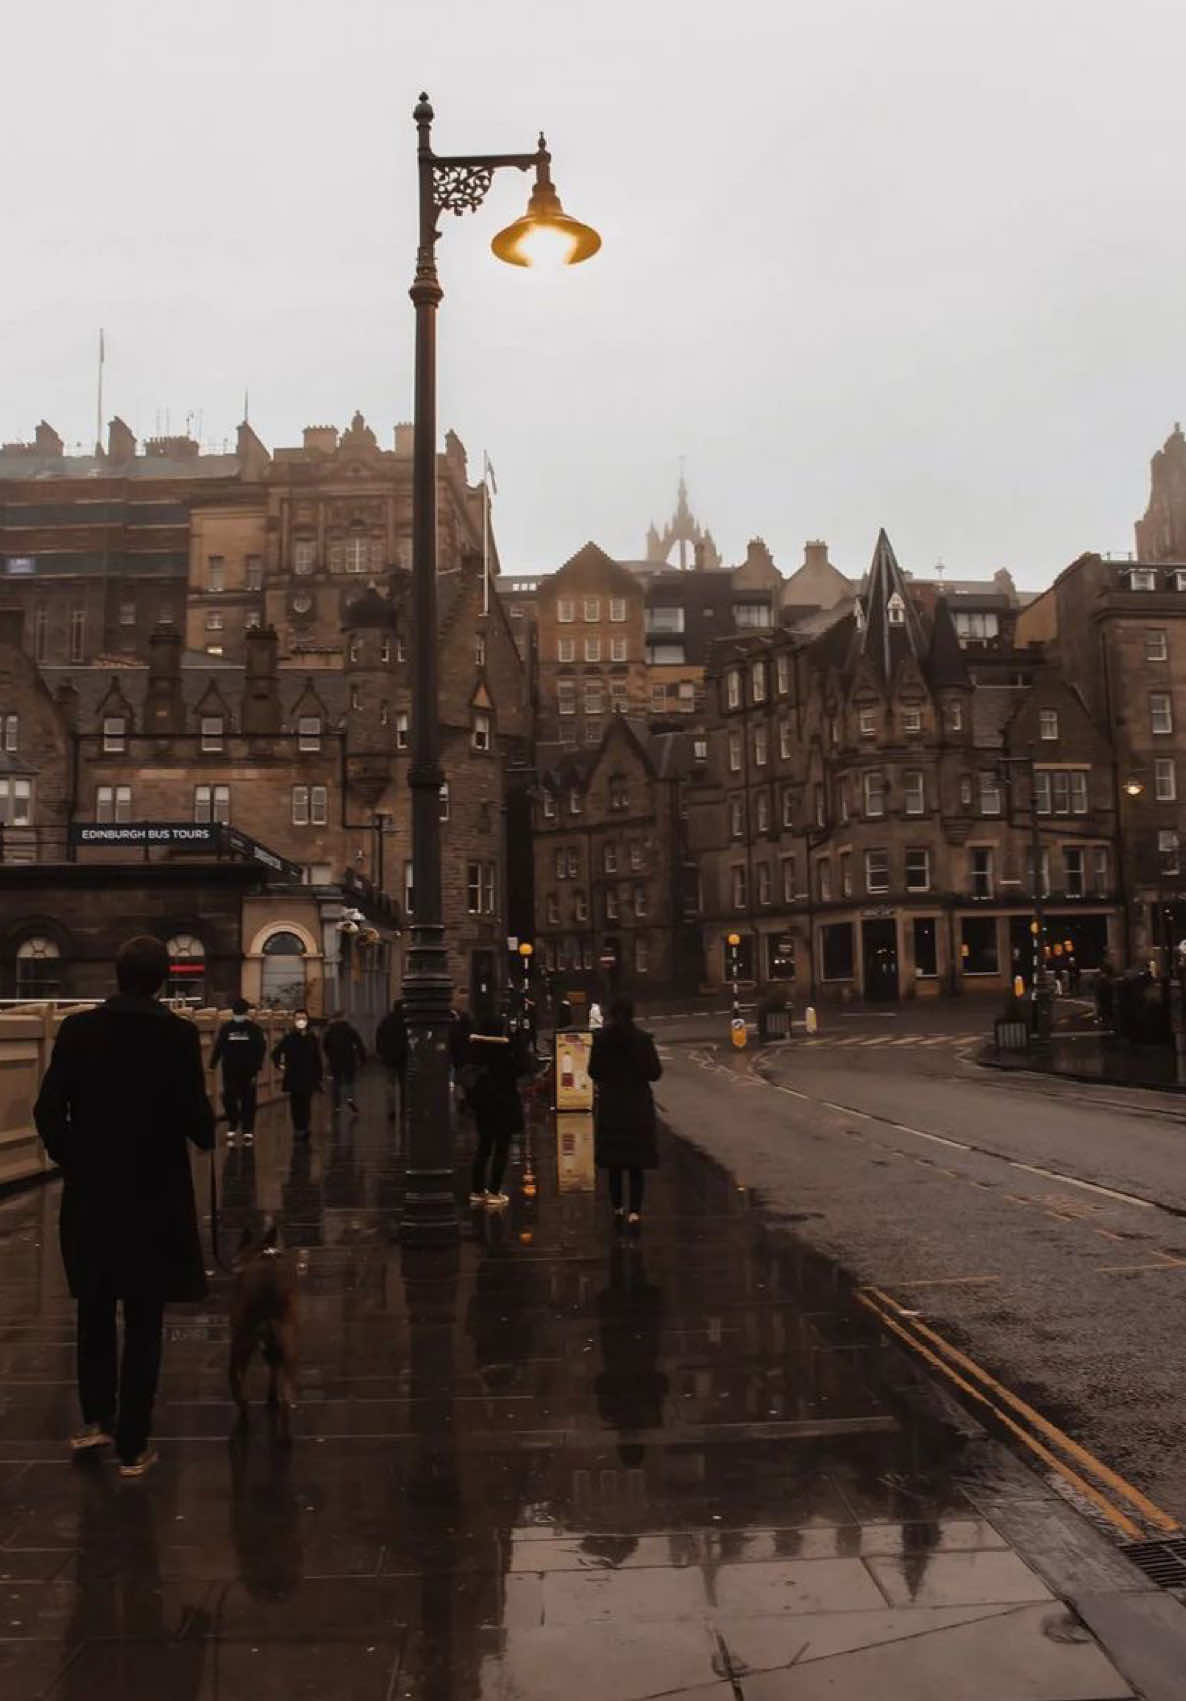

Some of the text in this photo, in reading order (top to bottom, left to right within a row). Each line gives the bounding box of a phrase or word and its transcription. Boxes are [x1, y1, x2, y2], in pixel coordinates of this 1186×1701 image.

[81, 829, 210, 840] EDINBURGH BUS TOURS
